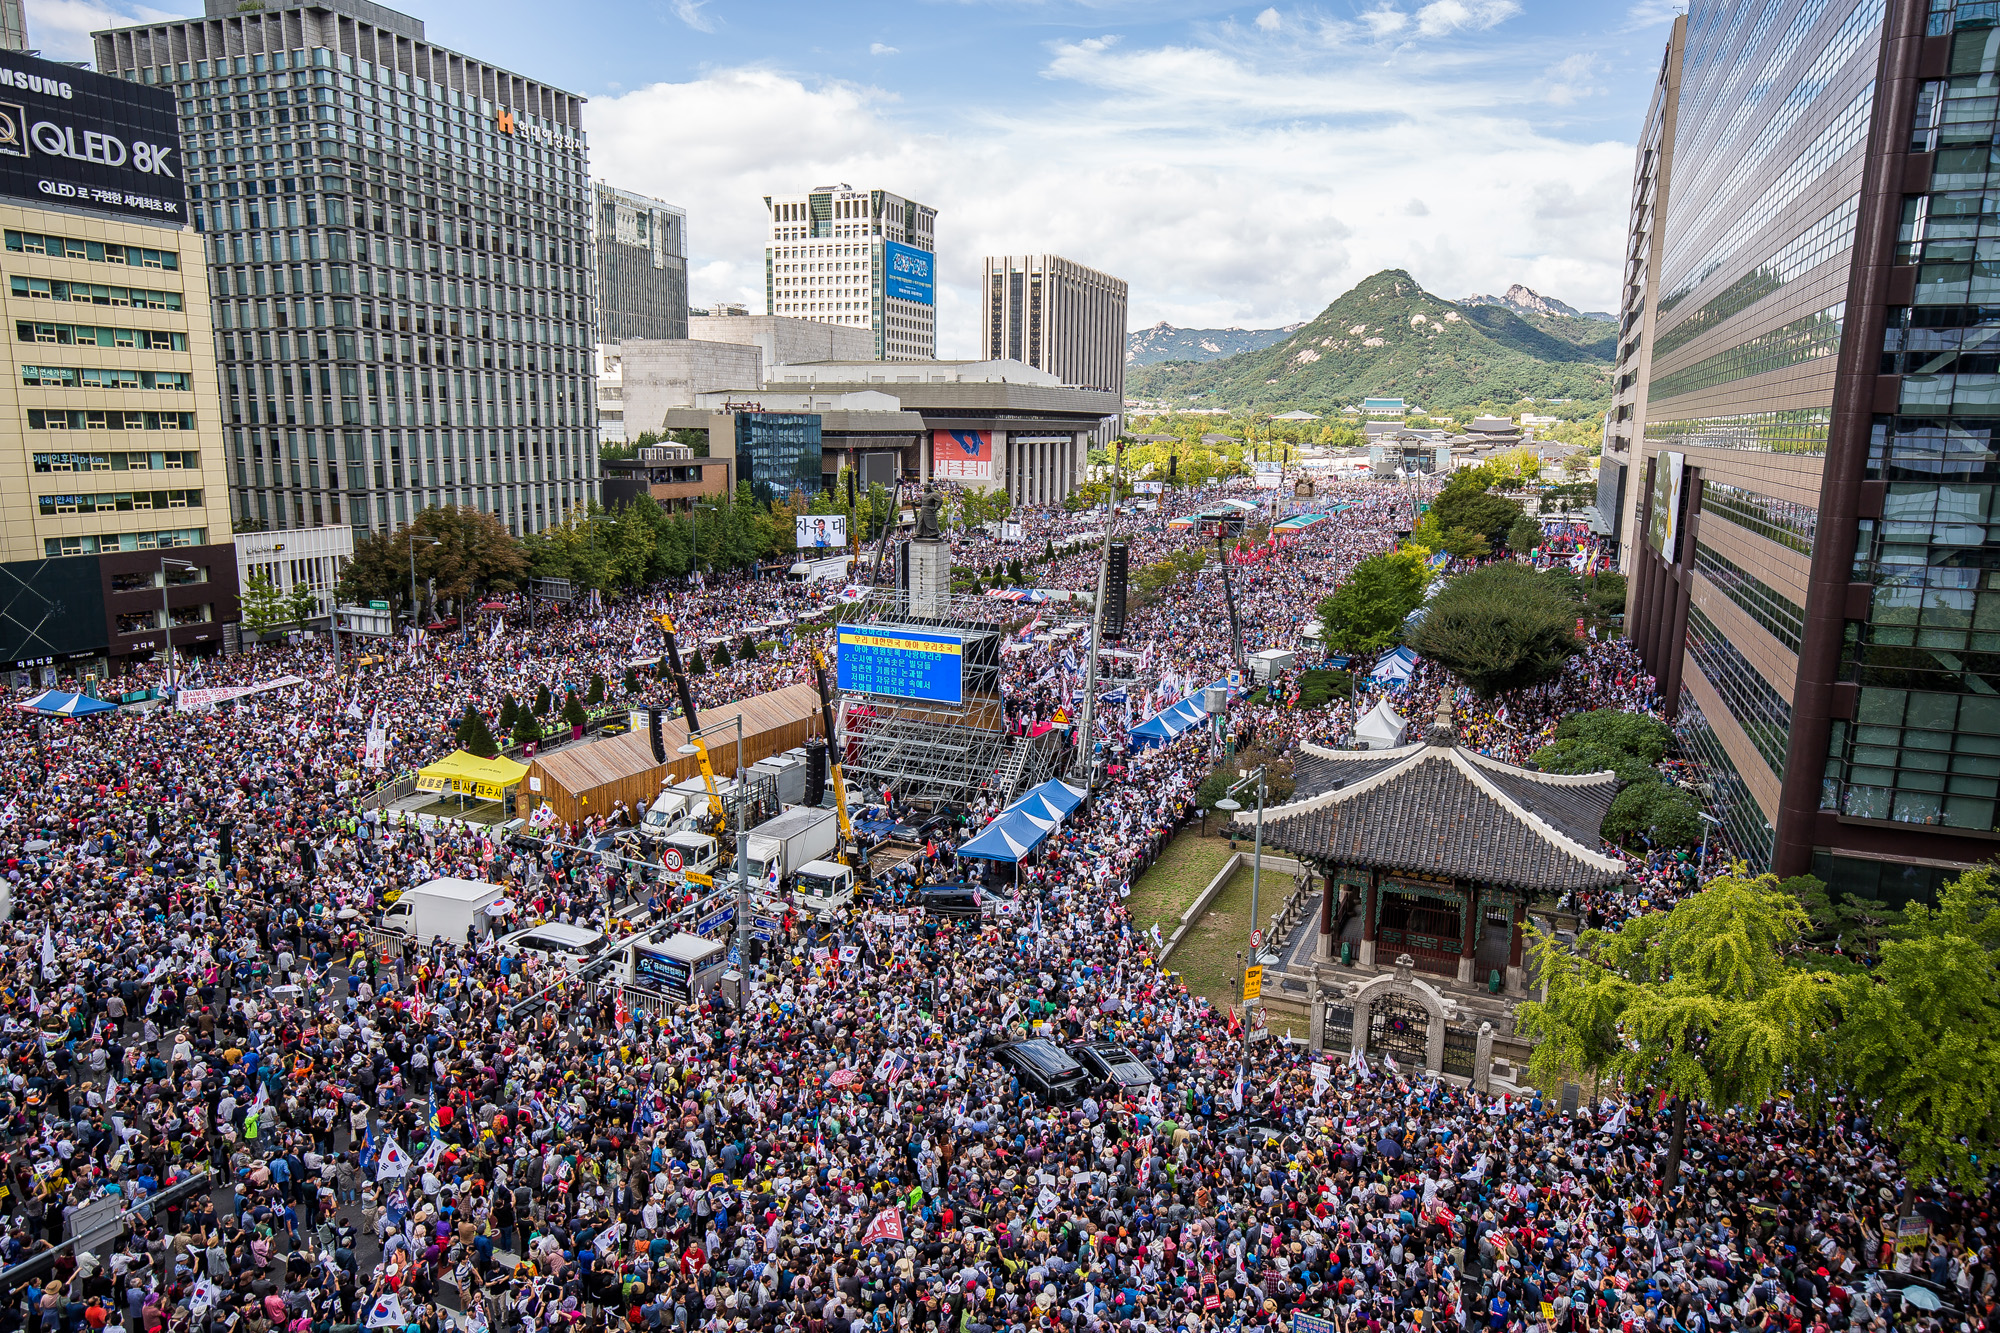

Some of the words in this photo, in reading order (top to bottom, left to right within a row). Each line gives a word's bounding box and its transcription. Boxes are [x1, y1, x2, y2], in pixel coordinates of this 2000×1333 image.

[30, 121, 127, 167] QLED
[132, 141, 175, 178] 8K
[38, 180, 76, 197] QLED
[77, 187, 90, 199] 로
[91, 189, 122, 205] 구현한
[124, 194, 163, 211] 세계최초
[164, 202, 178, 213] 8K
[840, 191, 857, 200] 외교부
[33, 453, 80, 464] 이비인후과
[80, 456, 104, 464] Dr.Kim
[831, 517, 845, 535] 대
[132, 641, 155, 651] 고디바
[854, 635, 868, 644] 우리
[872, 636, 901, 648] 대한민국
[905, 640, 919, 650] 아아
[923, 641, 953, 653] 우리조국
[854, 645, 869, 654] 아아
[904, 650, 942, 662] 사랑하리라
[876, 656, 906, 668] 우뚝솟은
[909, 660, 931, 670] 빌딩들
[851, 663, 873, 674] 농촌엔
[875, 665, 898, 677] 기름진
[901, 668, 924, 679] 논과밭
[851, 672, 873, 683] 저마다
[875, 675, 905, 687] 자유로움
[908, 679, 931, 690] 속에서
[418, 776, 444, 789] 세월호
[452, 780, 471, 792] 참사
[477, 785, 502, 798] 재수사
[667, 853, 679, 867] 50
